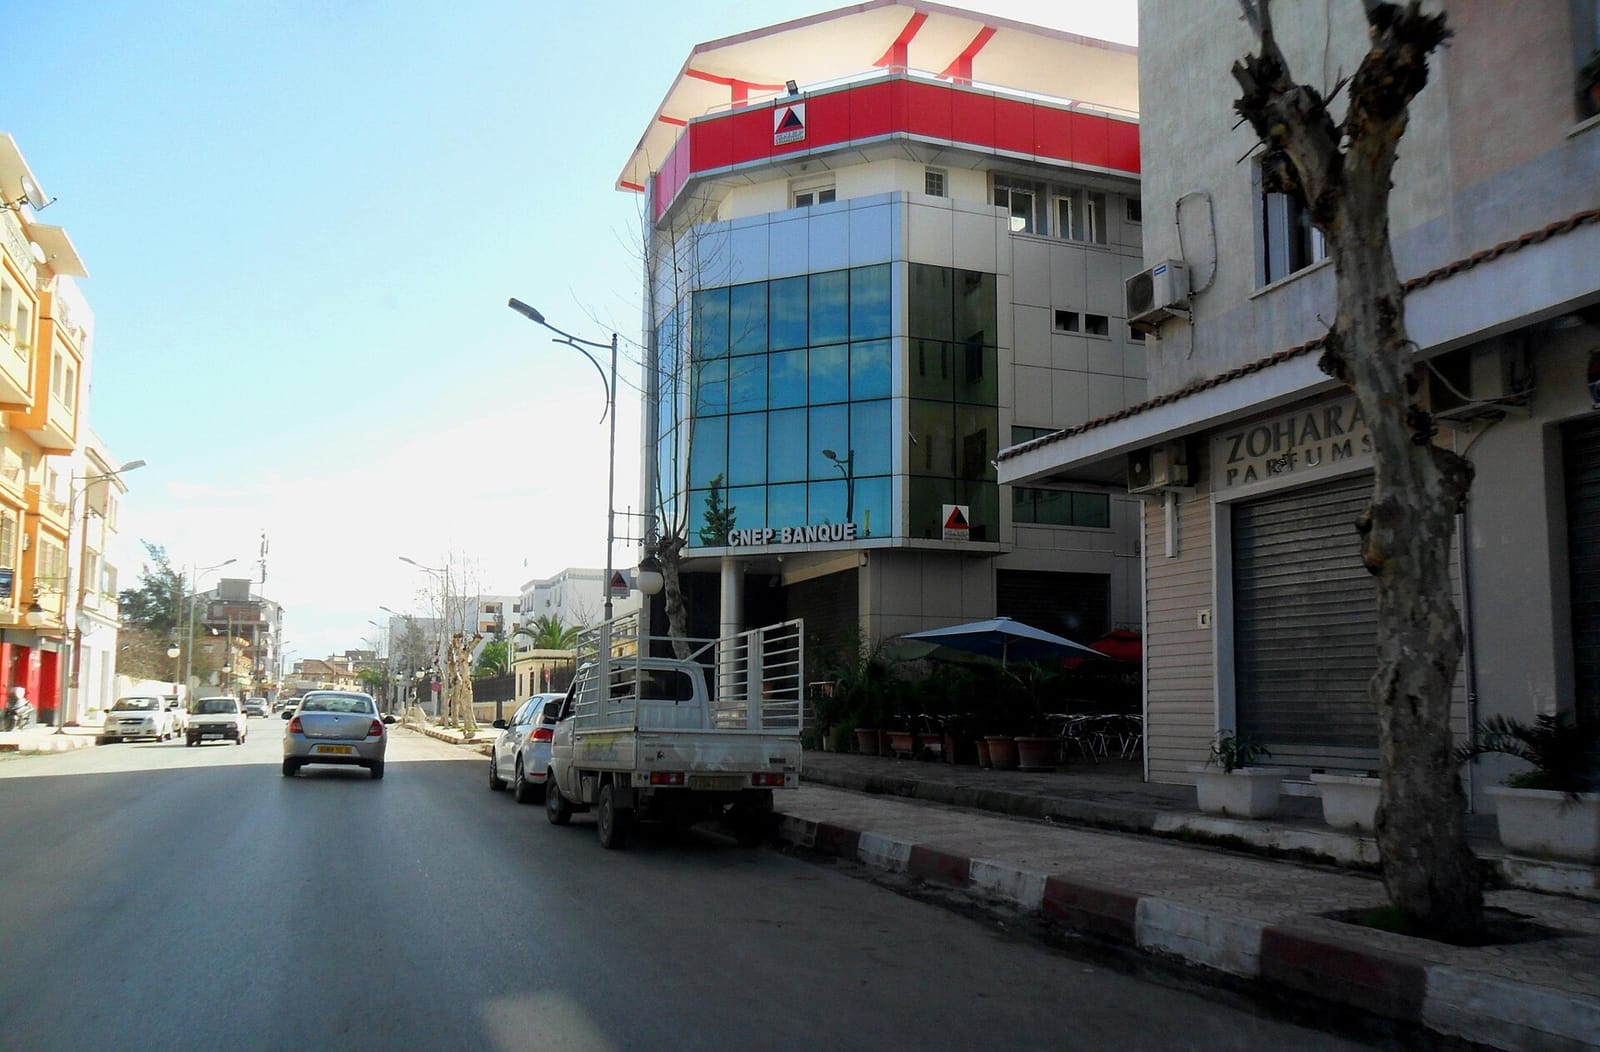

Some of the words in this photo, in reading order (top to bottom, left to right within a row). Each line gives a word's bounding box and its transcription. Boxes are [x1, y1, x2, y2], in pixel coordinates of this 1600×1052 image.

[1226, 398, 1368, 464] ZOHARA
[1226, 434, 1373, 486] PARFUMS
[728, 527, 774, 547] CNEP
[781, 522, 856, 544] BANQUE
